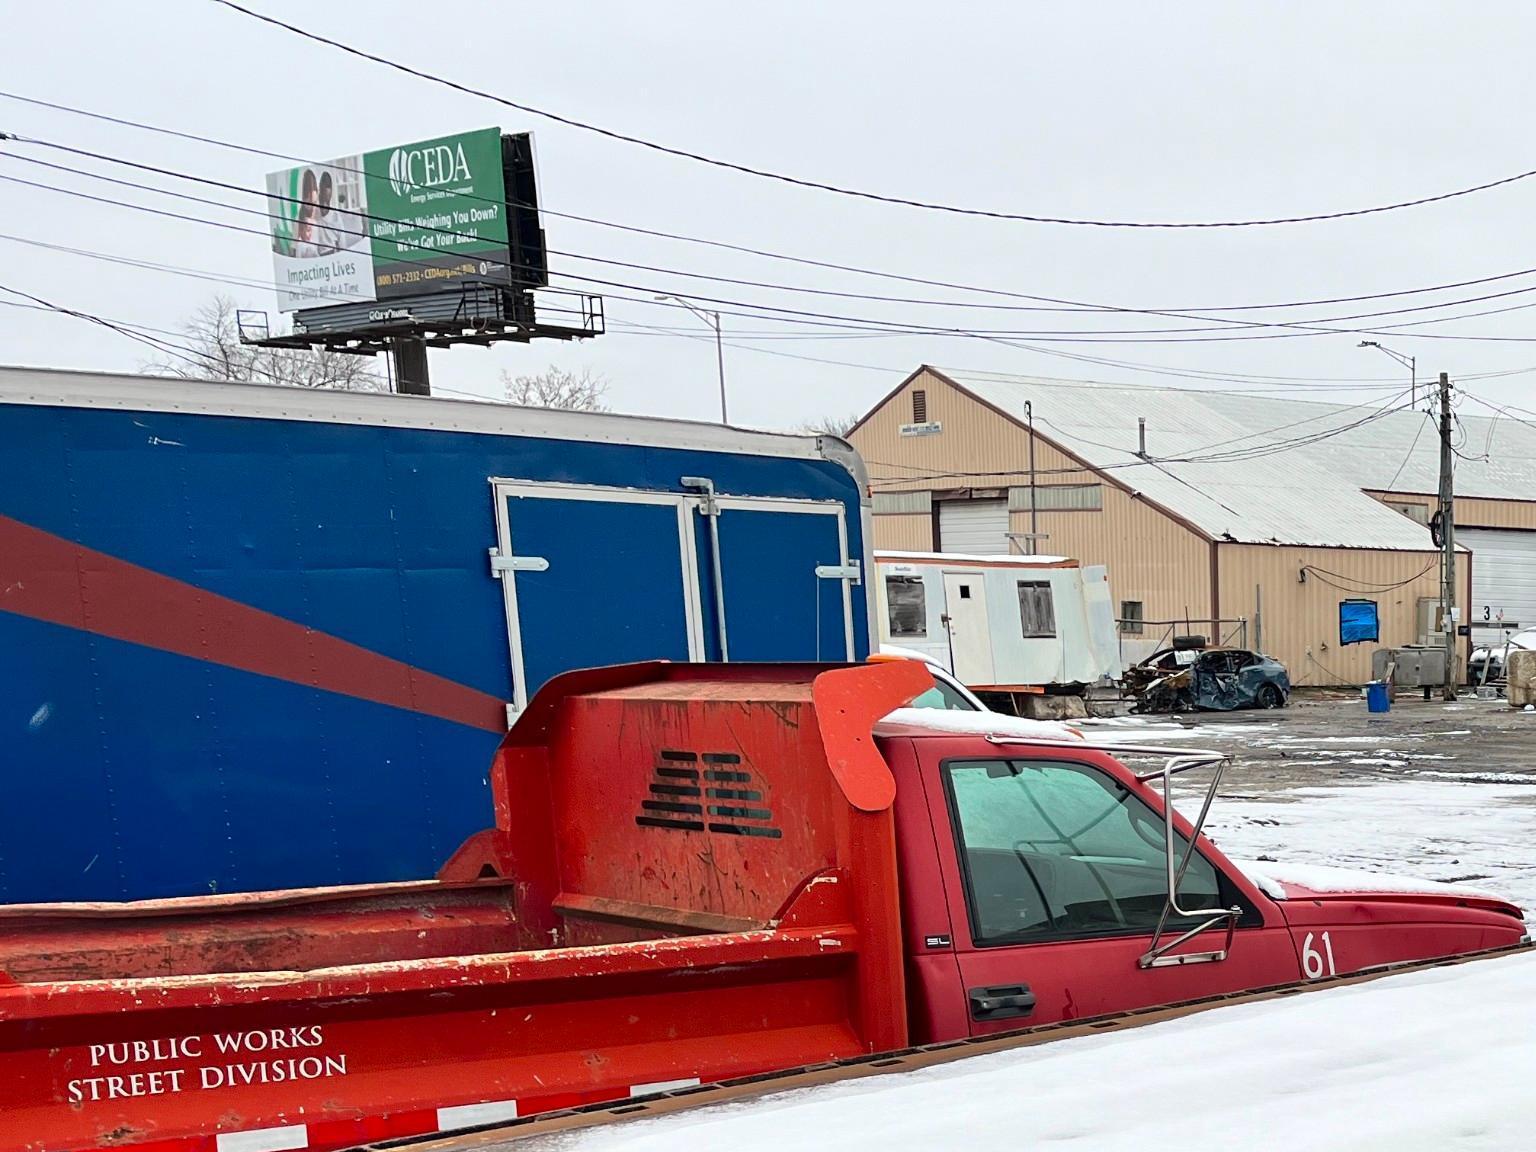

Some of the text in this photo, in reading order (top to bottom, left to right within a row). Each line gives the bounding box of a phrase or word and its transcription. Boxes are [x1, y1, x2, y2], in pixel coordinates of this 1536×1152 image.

[408, 142, 472, 189] CEDA
[374, 222, 396, 236] Utility
[415, 213, 452, 229] Weighing
[453, 210, 469, 224] You
[470, 204, 498, 221] Down?
[420, 235, 435, 248] Got
[436, 233, 455, 246] Your
[287, 261, 356, 285] Impacting Lives
[1483, 605, 1491, 621] 3
[926, 937, 950, 946] SL
[1302, 931, 1336, 979] 61
[89, 1025, 323, 1067] PUBLIC WORKS
[68, 1054, 348, 1103] STREET DIVISION
